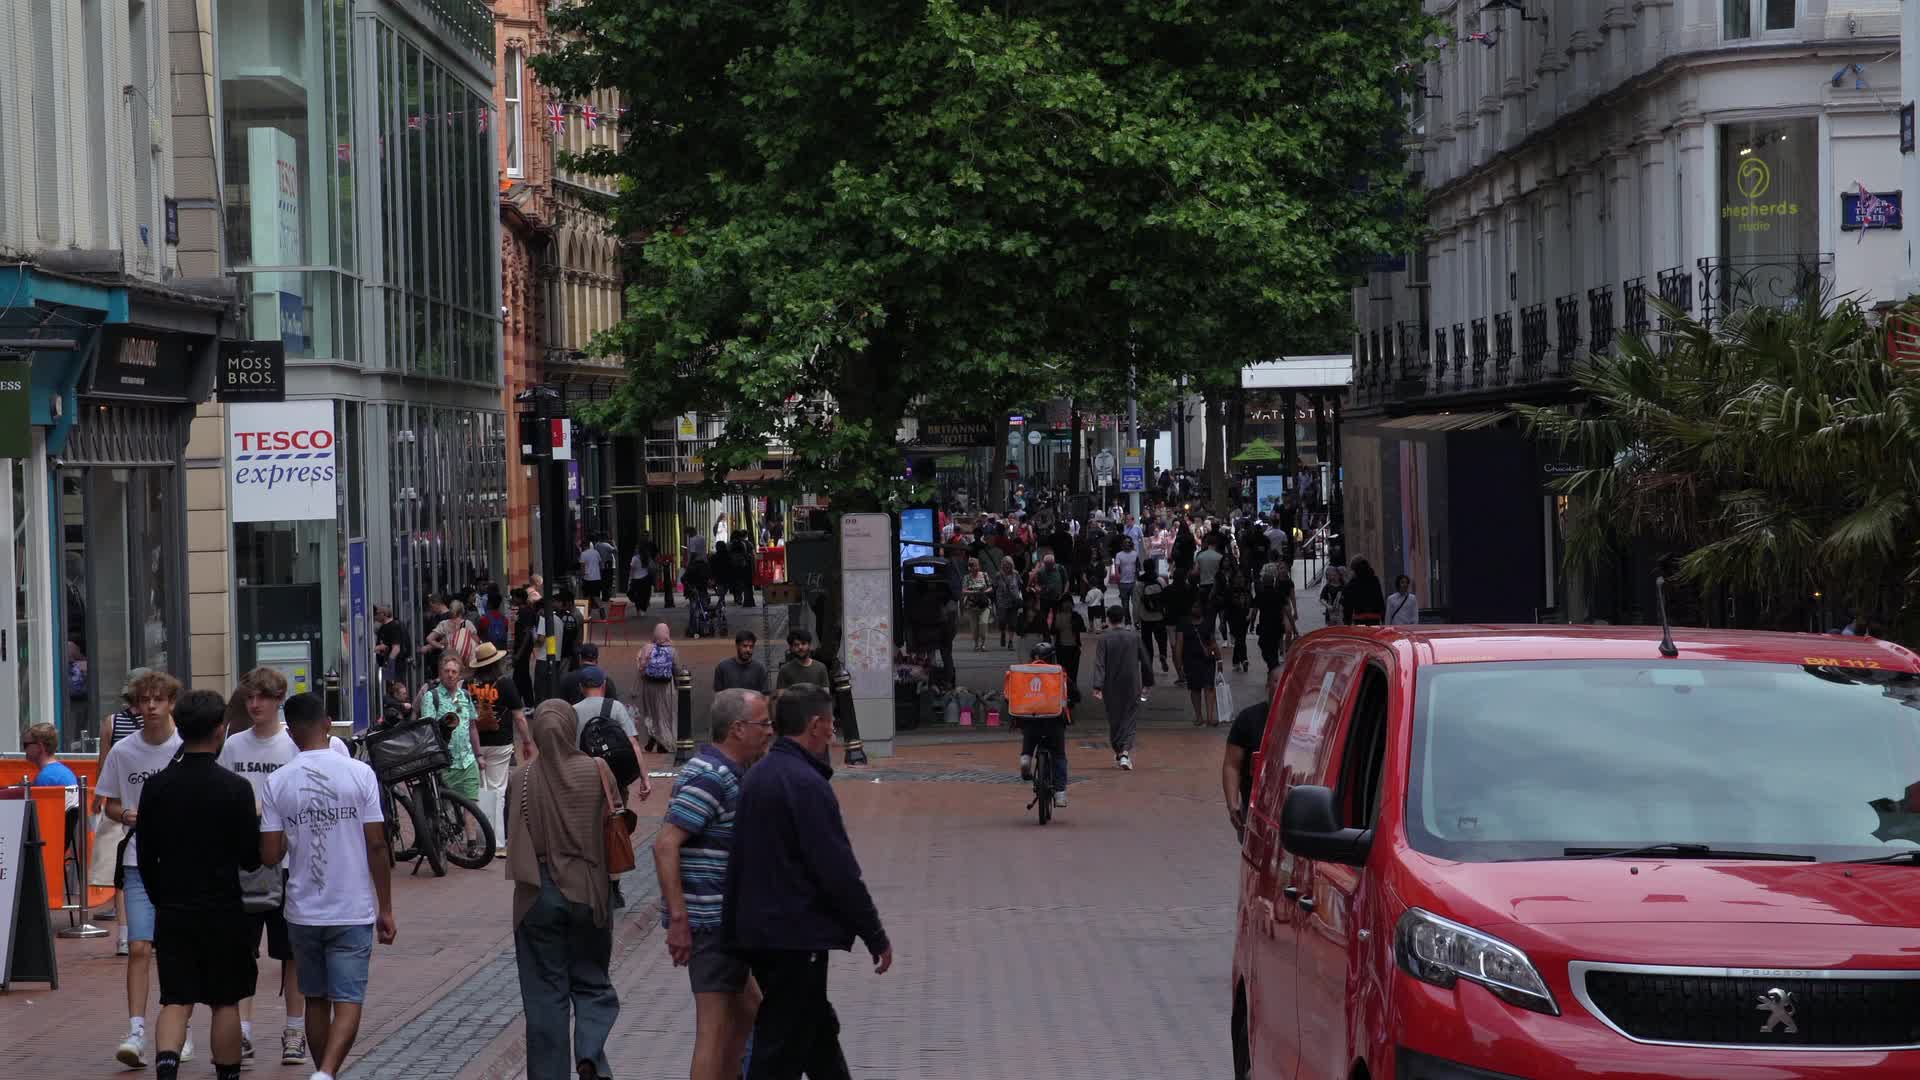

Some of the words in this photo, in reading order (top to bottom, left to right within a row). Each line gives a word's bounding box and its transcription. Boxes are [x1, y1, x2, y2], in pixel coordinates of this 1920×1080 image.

[1722, 202, 1799, 218] shepherds
[228, 357, 272, 370] MOSS
[228, 371, 276, 384] BROS.
[928, 423, 989, 434] BRITANNIA
[234, 430, 333, 451] TESCO
[236, 464, 334, 490] express
[1803, 657, 1840, 667] BM
[1842, 659, 1882, 669] 112
